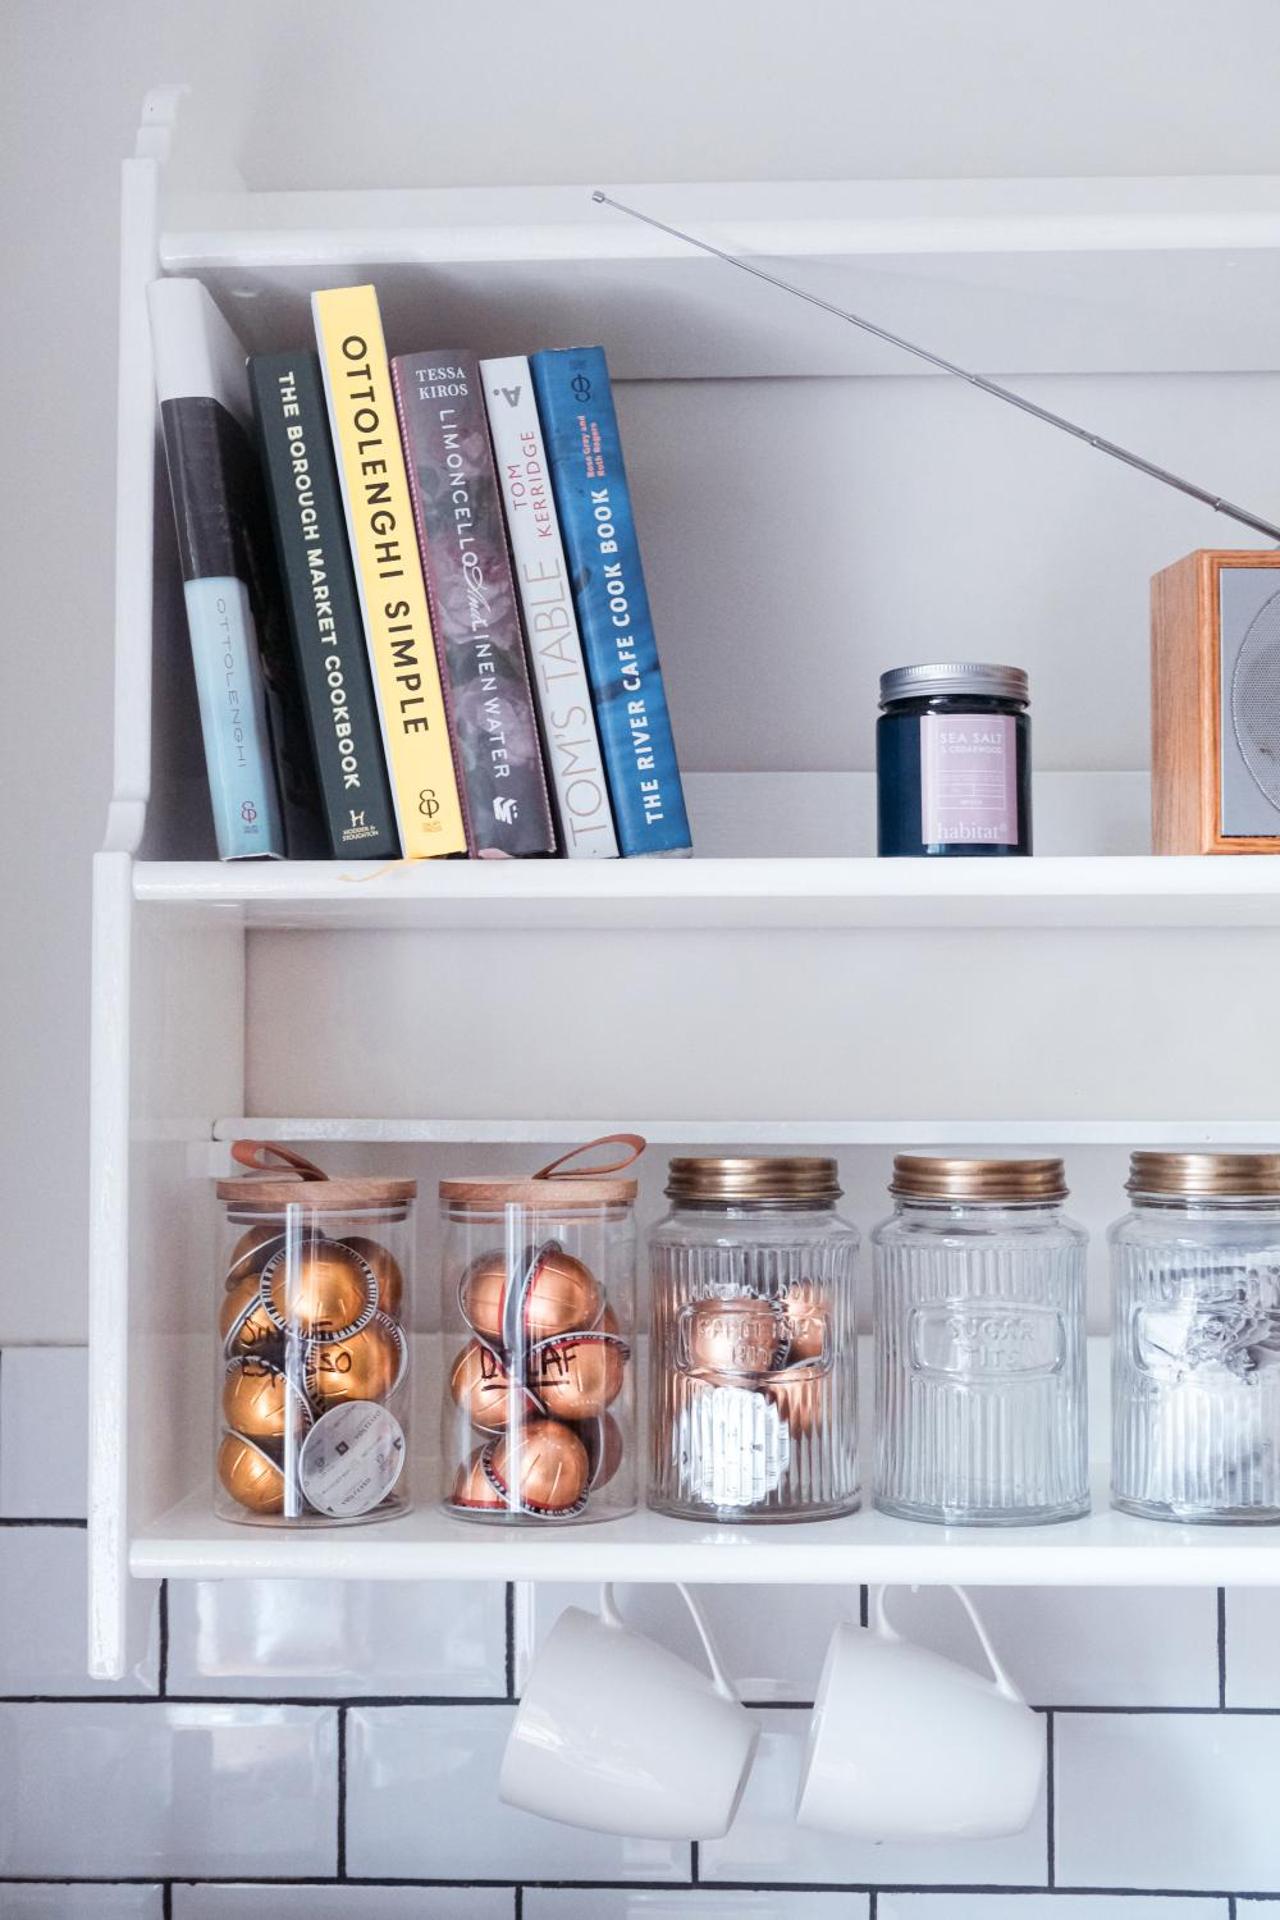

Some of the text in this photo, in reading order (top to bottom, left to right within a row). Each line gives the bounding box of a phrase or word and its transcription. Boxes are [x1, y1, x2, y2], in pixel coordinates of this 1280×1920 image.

[415, 366, 466, 382] TESSA
[419, 383, 468, 400] KIROS
[439, 409, 478, 567] LIMONCELLO
[507, 465, 525, 510] TOM
[521, 431, 553, 538] KERRIDGE
[278, 371, 360, 789] THE BOROUGH MARKET COOKBOOK
[342, 335, 429, 734] OTTOLENGHI SIMPLE
[217, 597, 247, 768] OTTOLENGHI
[472, 622, 497, 691] LINEN
[523, 558, 607, 847] TOM'S TABLE
[591, 488, 663, 825] THE RIVER CAFE COOK BOOK
[484, 696, 510, 779] WATER
[940, 733, 1002, 744] SEA SALT
[938, 822, 999, 839] habitat
